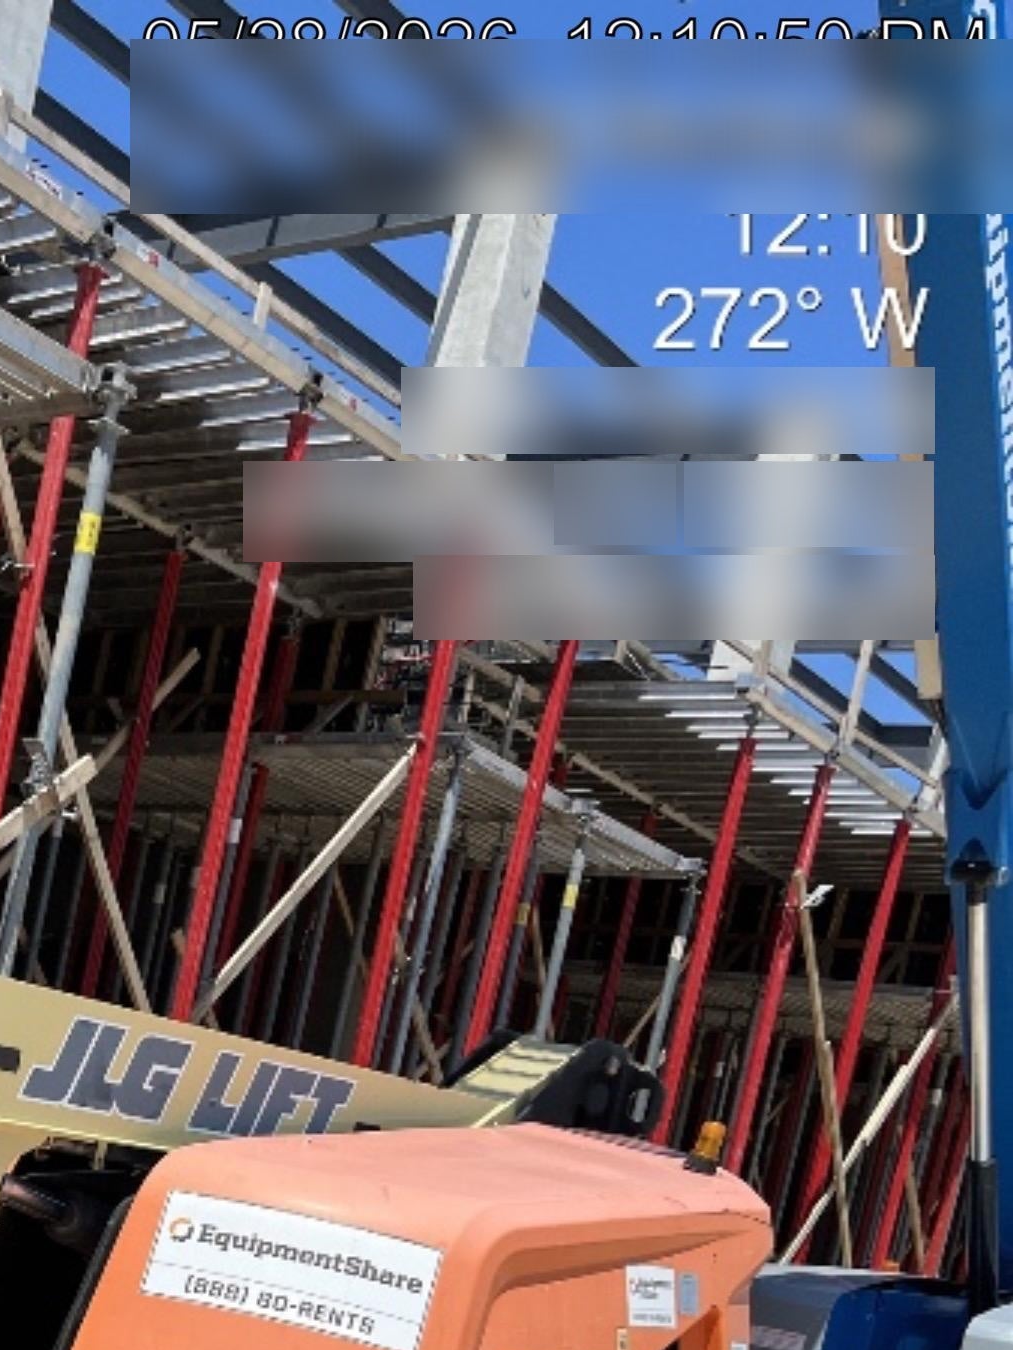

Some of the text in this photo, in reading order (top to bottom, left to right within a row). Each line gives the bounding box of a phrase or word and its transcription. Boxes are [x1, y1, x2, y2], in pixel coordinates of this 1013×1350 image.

[17, 1016, 357, 1138] JLG LIFT
[184, 1274, 250, 1305] (888)
[196, 1222, 424, 1295] EquipmentShare
